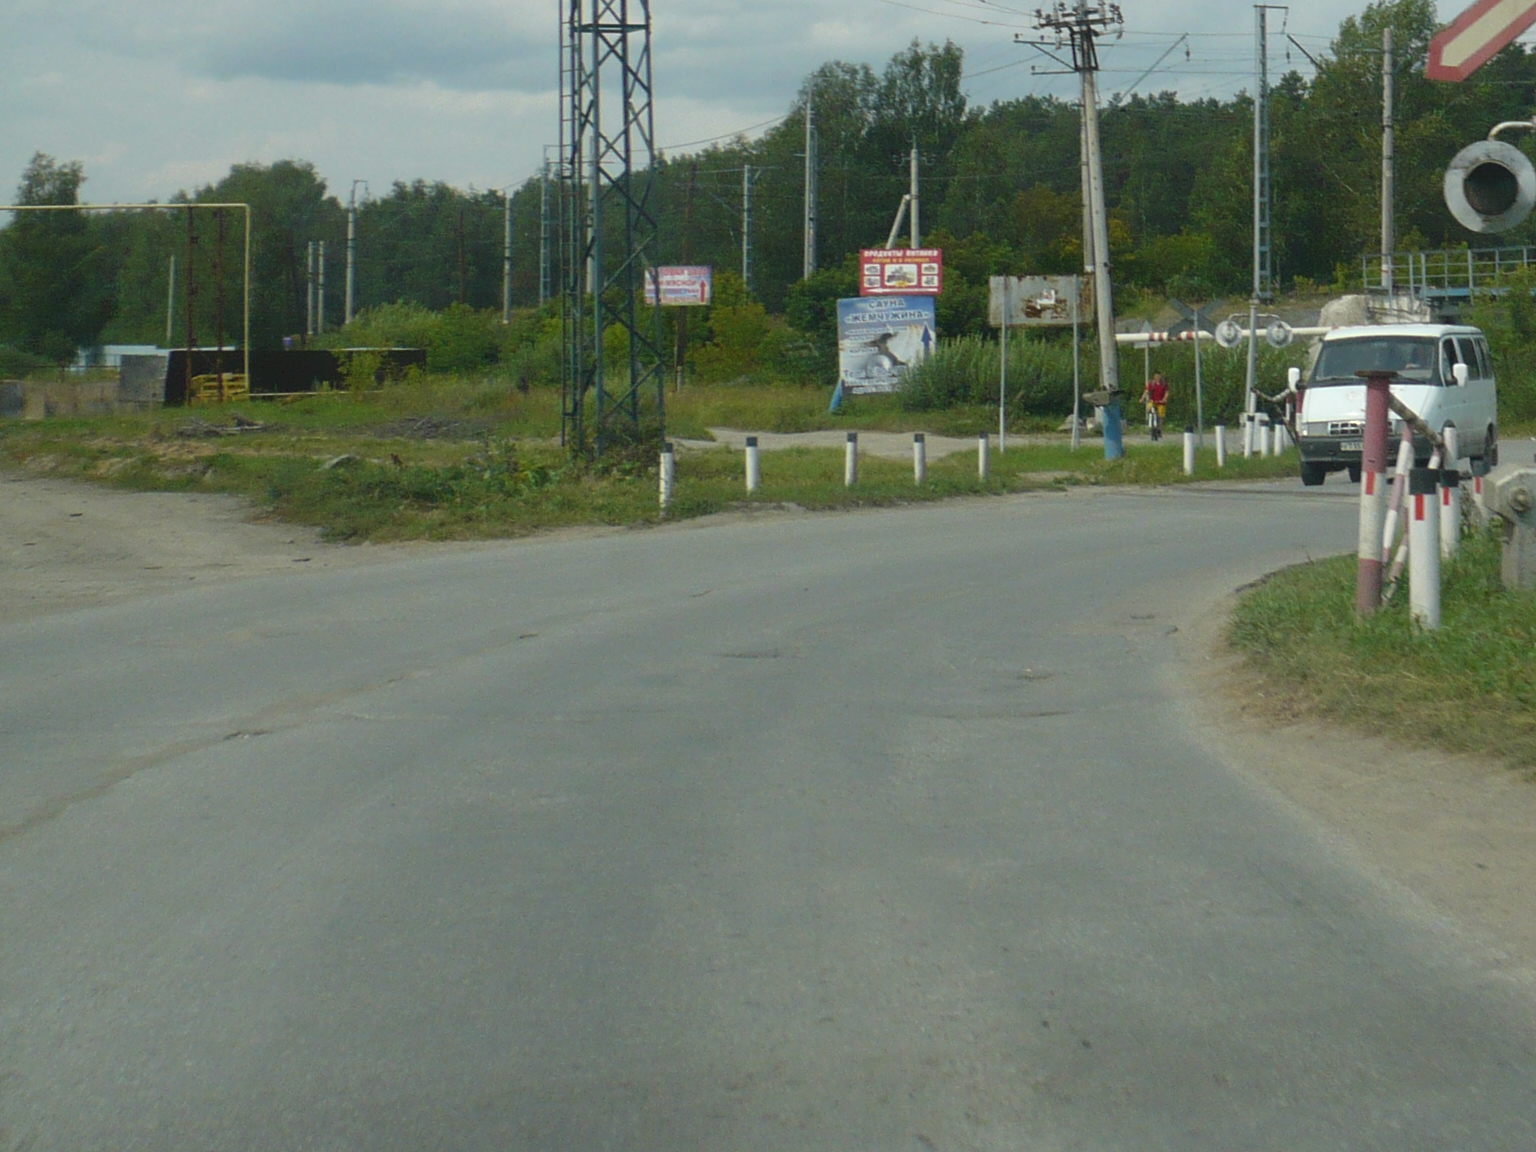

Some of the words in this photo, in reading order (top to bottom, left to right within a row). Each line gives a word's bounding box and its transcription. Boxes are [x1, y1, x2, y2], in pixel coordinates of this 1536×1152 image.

[864, 249, 904, 258] ПРОДУКТЫ
[869, 298, 905, 308] САУНА
[845, 311, 930, 323] «ЖЕМЧУЖИНА»
